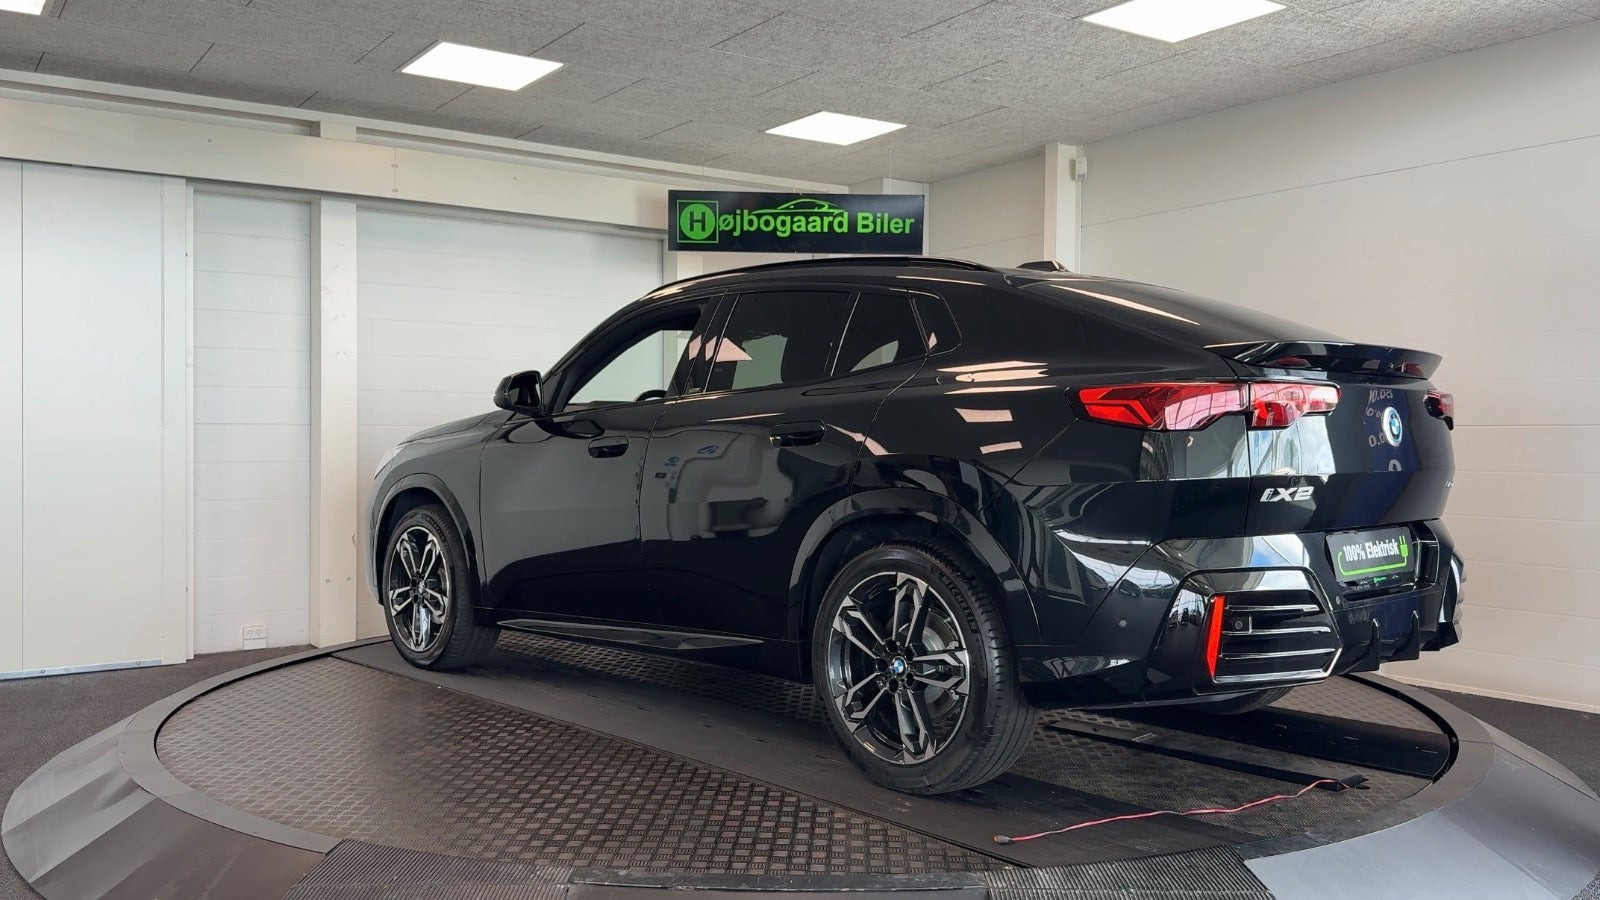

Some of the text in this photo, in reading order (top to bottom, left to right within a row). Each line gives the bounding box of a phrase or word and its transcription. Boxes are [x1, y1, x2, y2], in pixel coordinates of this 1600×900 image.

[687, 208, 915, 238] Højbogaard Biler
[1260, 486, 1314, 502] iX2
[1343, 539, 1400, 562] 100% Elektrisk
